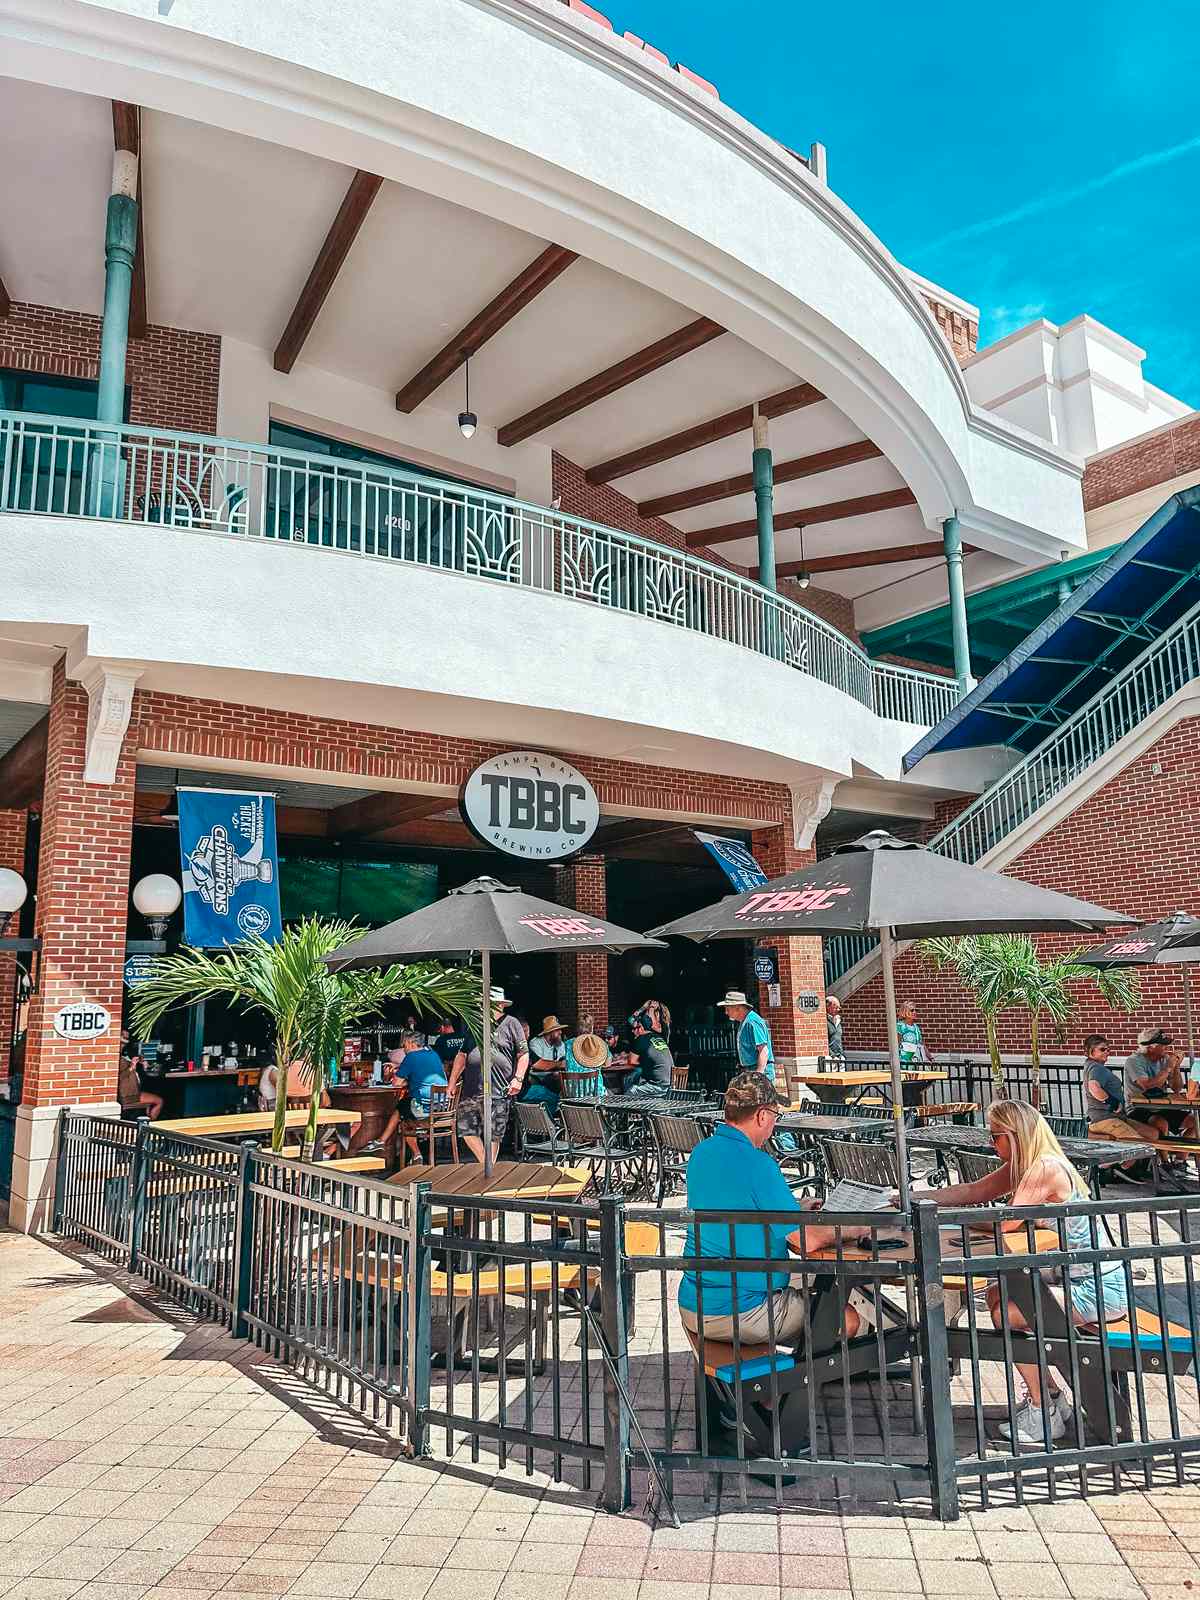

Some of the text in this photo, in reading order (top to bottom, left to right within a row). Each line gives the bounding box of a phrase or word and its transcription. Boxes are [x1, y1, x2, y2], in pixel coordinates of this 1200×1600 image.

[495, 757, 574, 778] TAMPA BAY
[481, 774, 586, 835] TBBC
[240, 805, 252, 838] HOCKEY
[494, 832, 575, 854] BREWING CO
[214, 827, 227, 913] CHAMPIONS
[735, 887, 851, 914] TBBC
[518, 919, 605, 936] TBBC
[800, 996, 819, 1008] TBBC
[61, 1012, 105, 1031] TBBC
